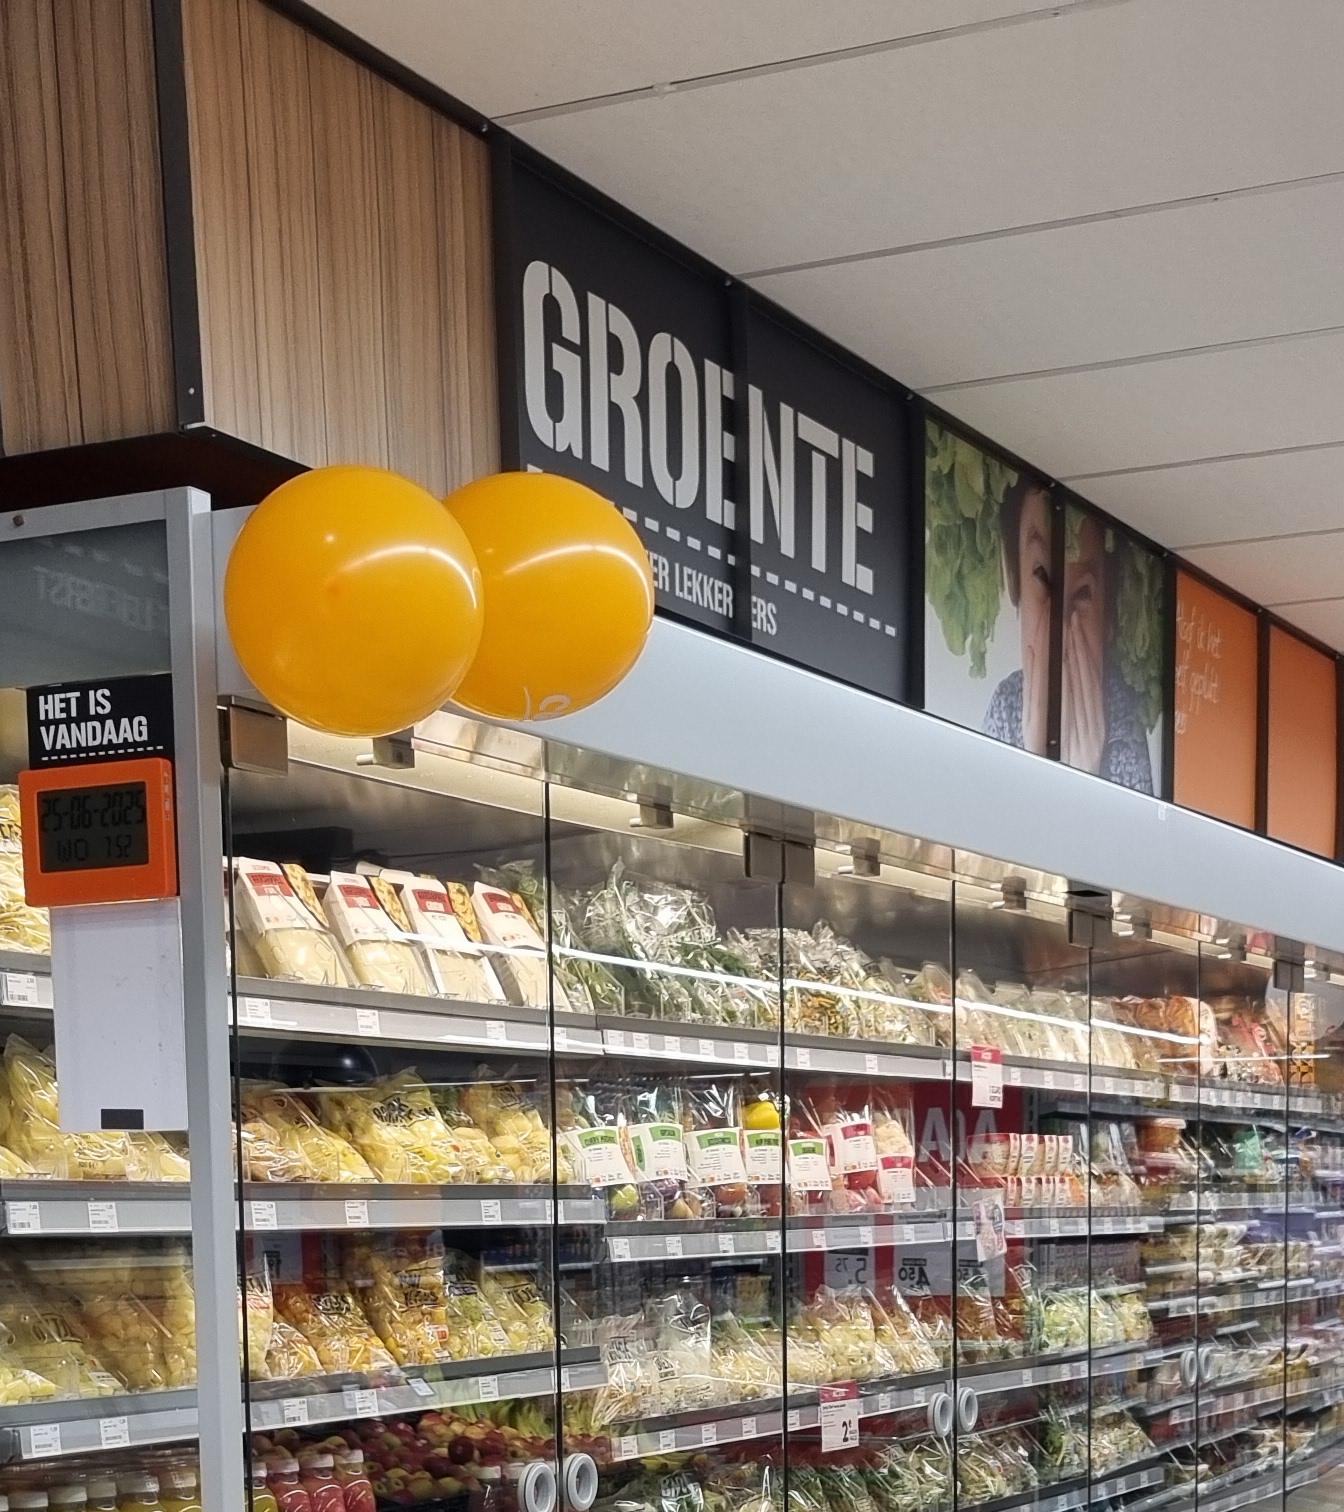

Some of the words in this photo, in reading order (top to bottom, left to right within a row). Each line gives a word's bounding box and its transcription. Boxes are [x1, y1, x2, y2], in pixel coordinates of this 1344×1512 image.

[523, 260, 873, 594] GROENTE
[646, 550, 670, 592] ER
[675, 563, 733, 618] LEKKER
[751, 595, 777, 636] ERS
[39, 692, 80, 720] HET
[89, 688, 111, 716] IS
[40, 716, 148, 750] VANDAAG
